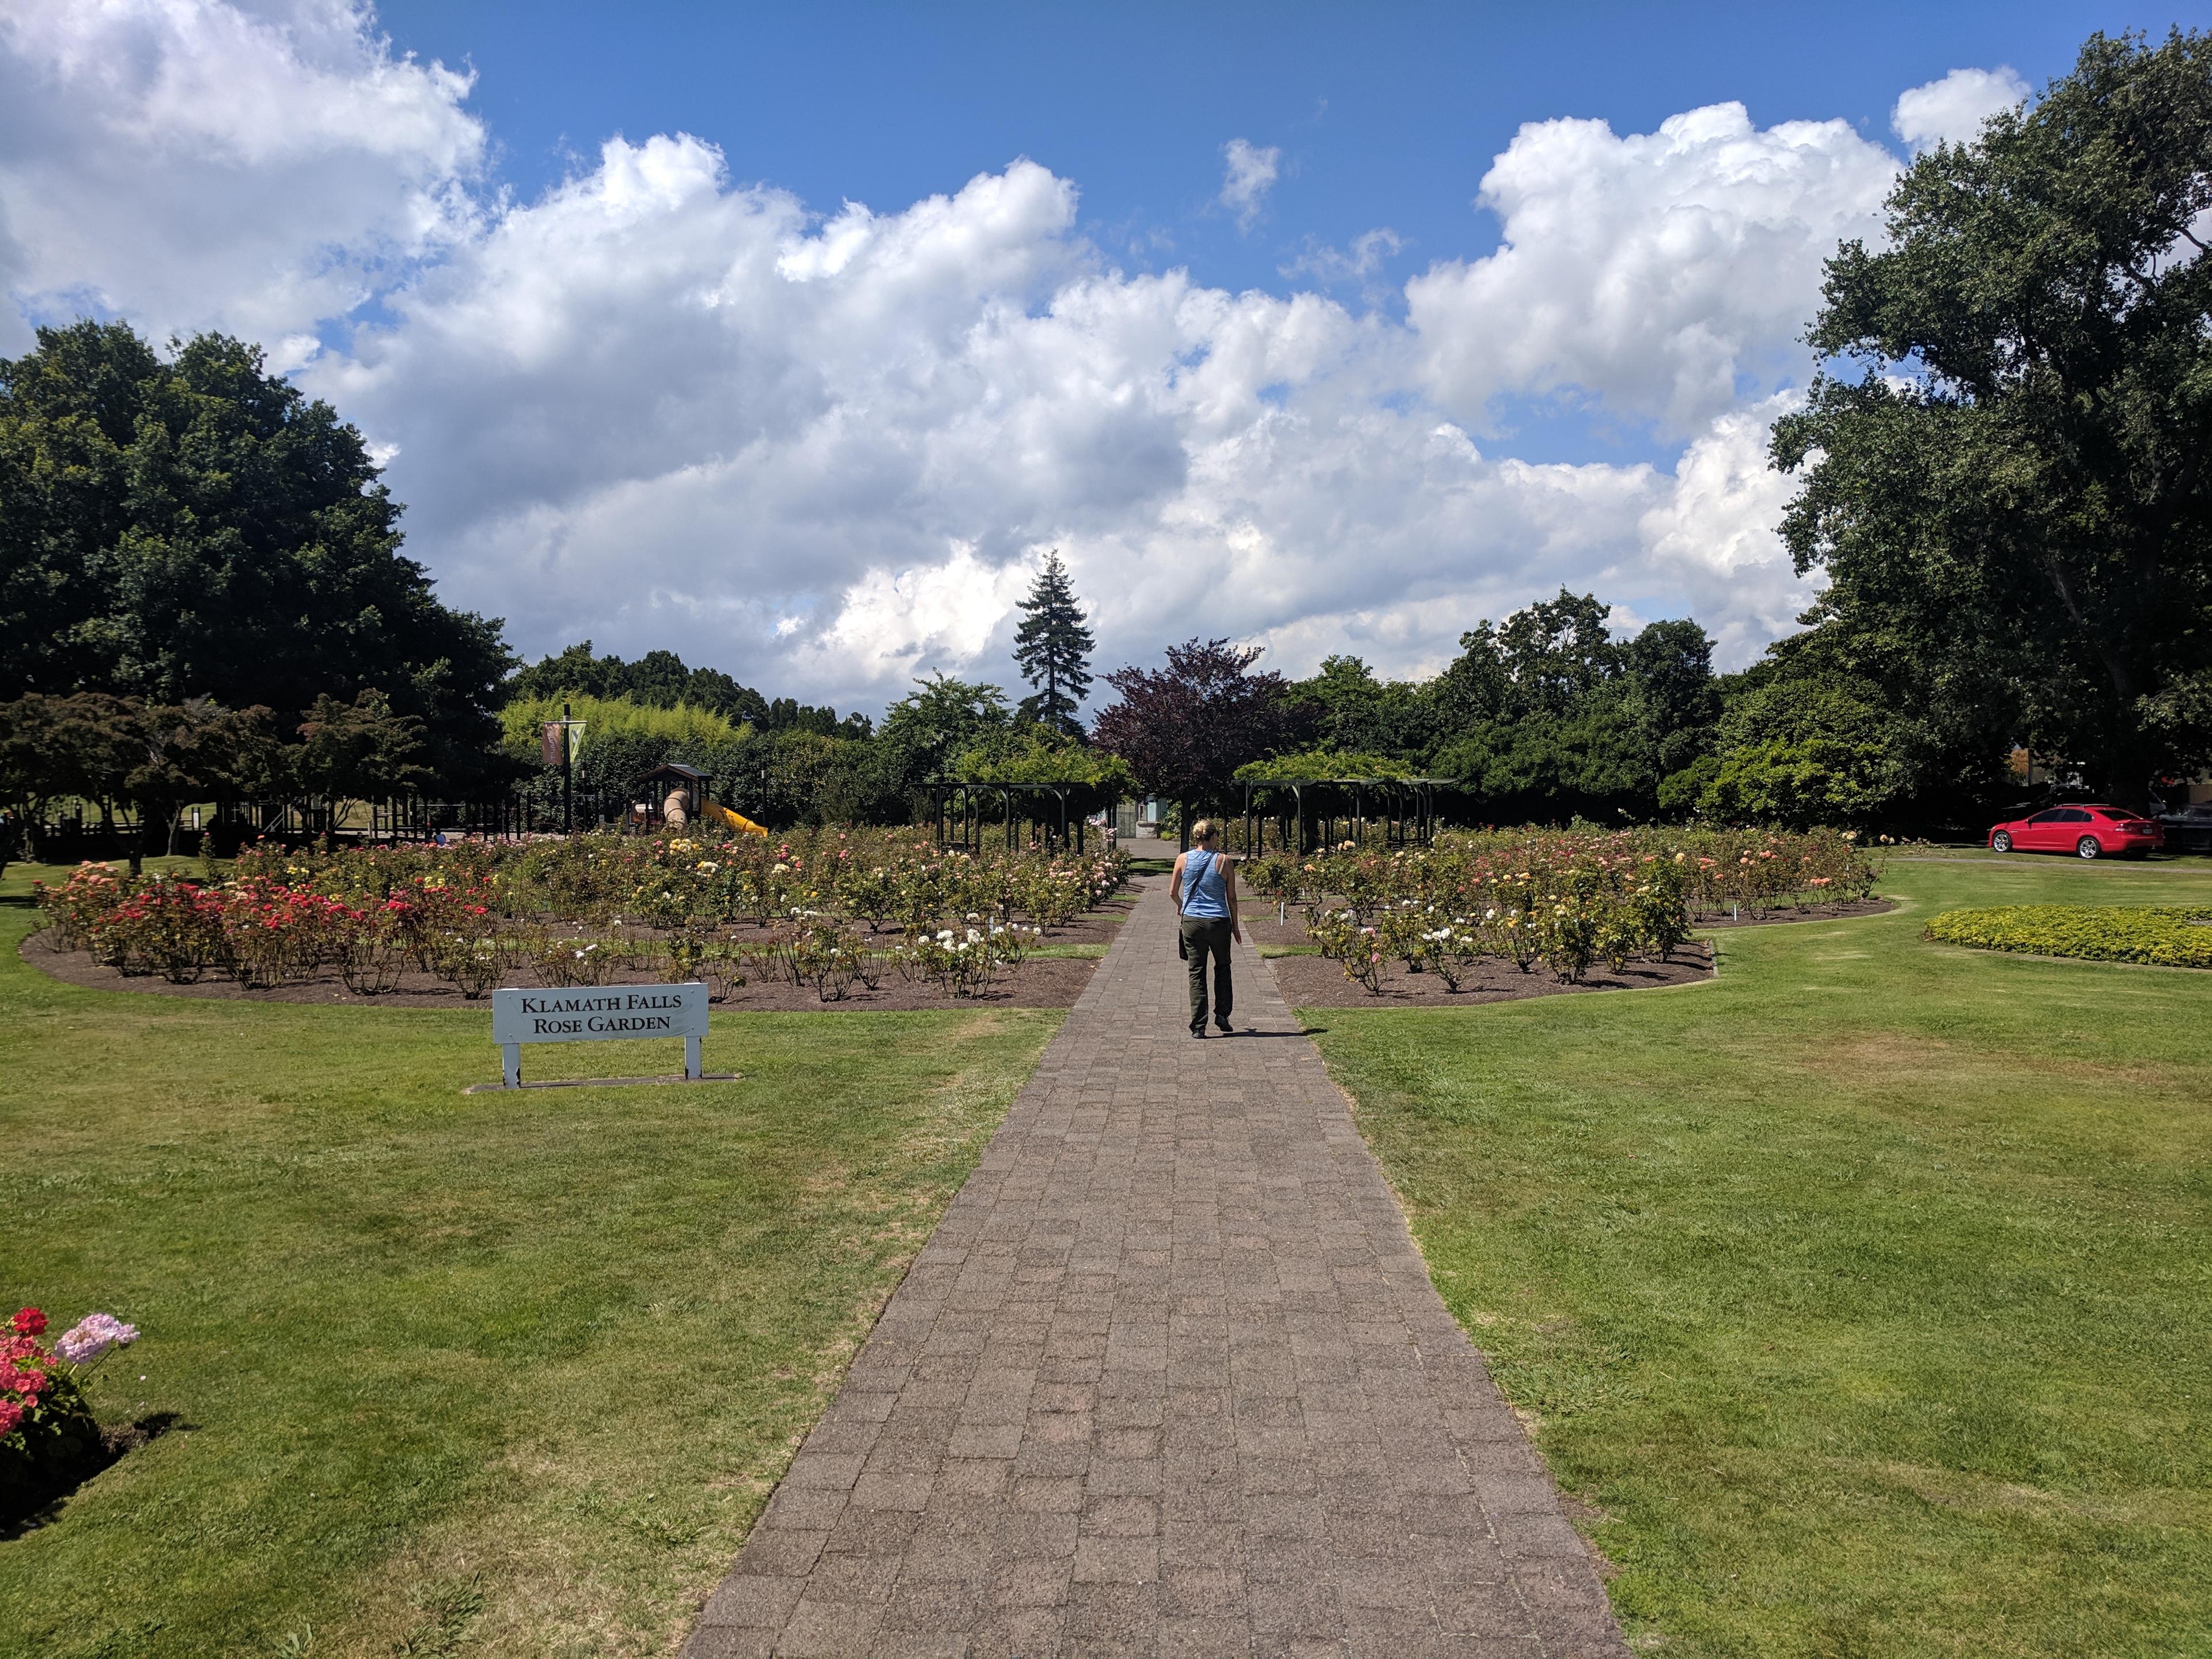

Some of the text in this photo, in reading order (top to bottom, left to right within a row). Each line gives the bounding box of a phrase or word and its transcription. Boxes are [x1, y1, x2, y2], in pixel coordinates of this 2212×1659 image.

[521, 994, 682, 1014] KLAMATH FALLS
[533, 1016, 671, 1034] ROSE GARDEN
